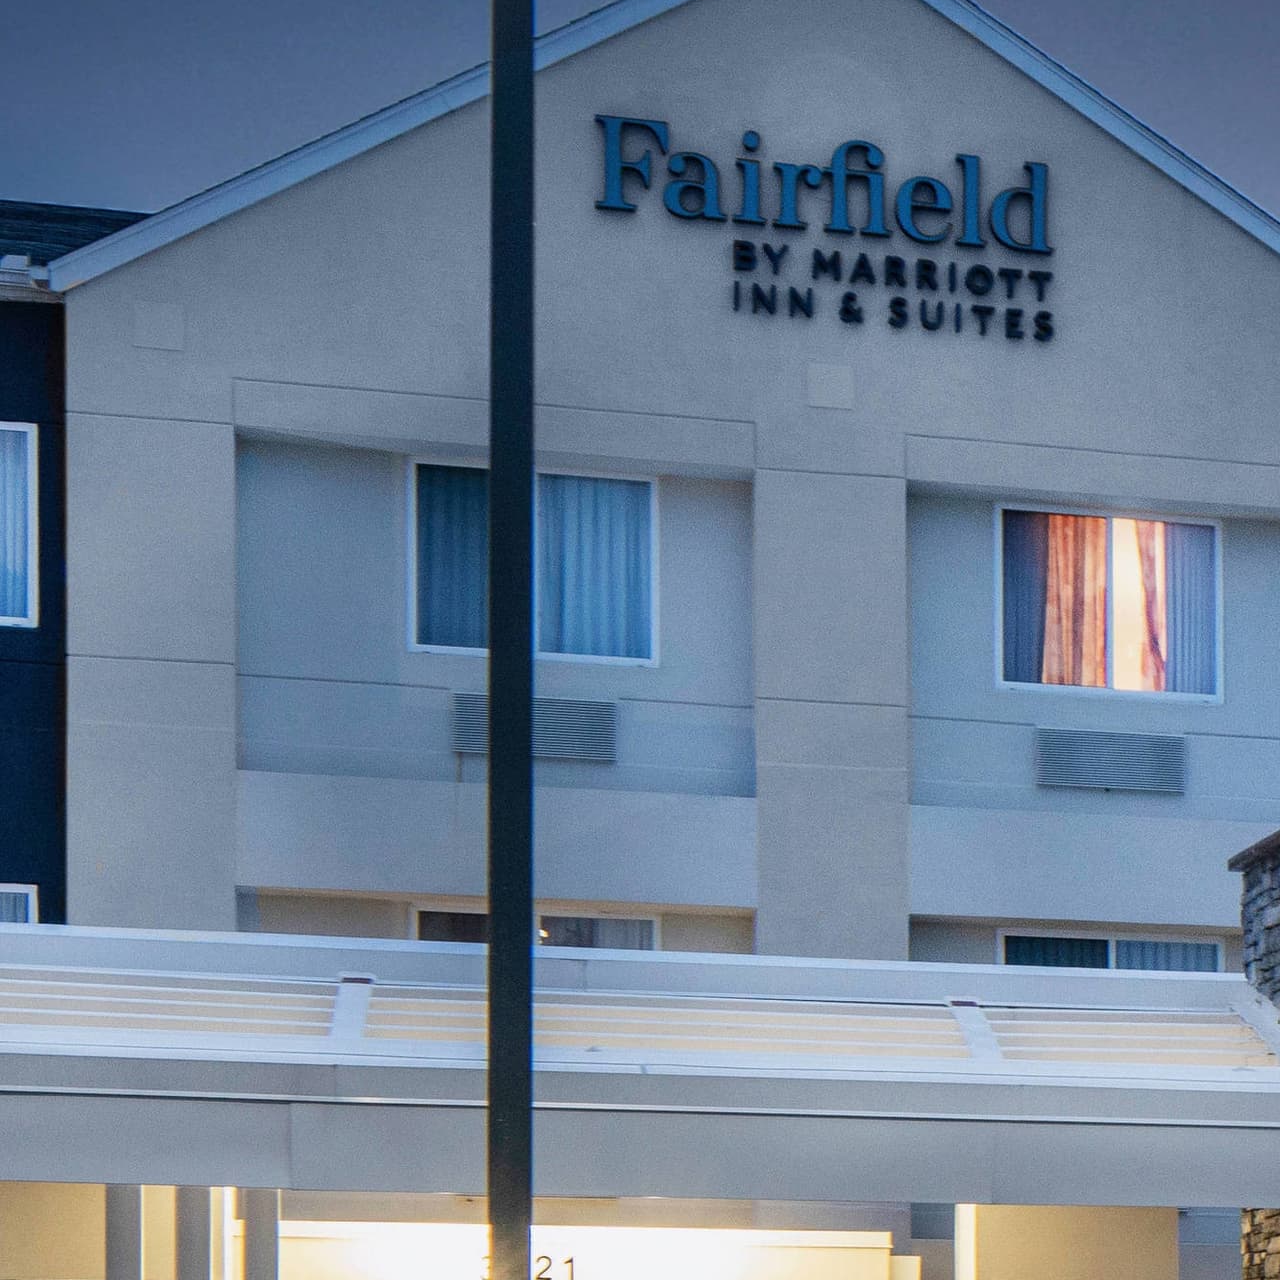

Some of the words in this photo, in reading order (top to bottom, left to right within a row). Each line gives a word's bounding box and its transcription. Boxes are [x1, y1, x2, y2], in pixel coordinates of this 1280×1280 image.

[595, 113, 1054, 256] Fairfield
[733, 239, 789, 276] BY
[811, 248, 1054, 303] MARRIOTT
[732, 280, 815, 320] INN
[838, 291, 864, 325] &
[888, 296, 1055, 342] SUITES
